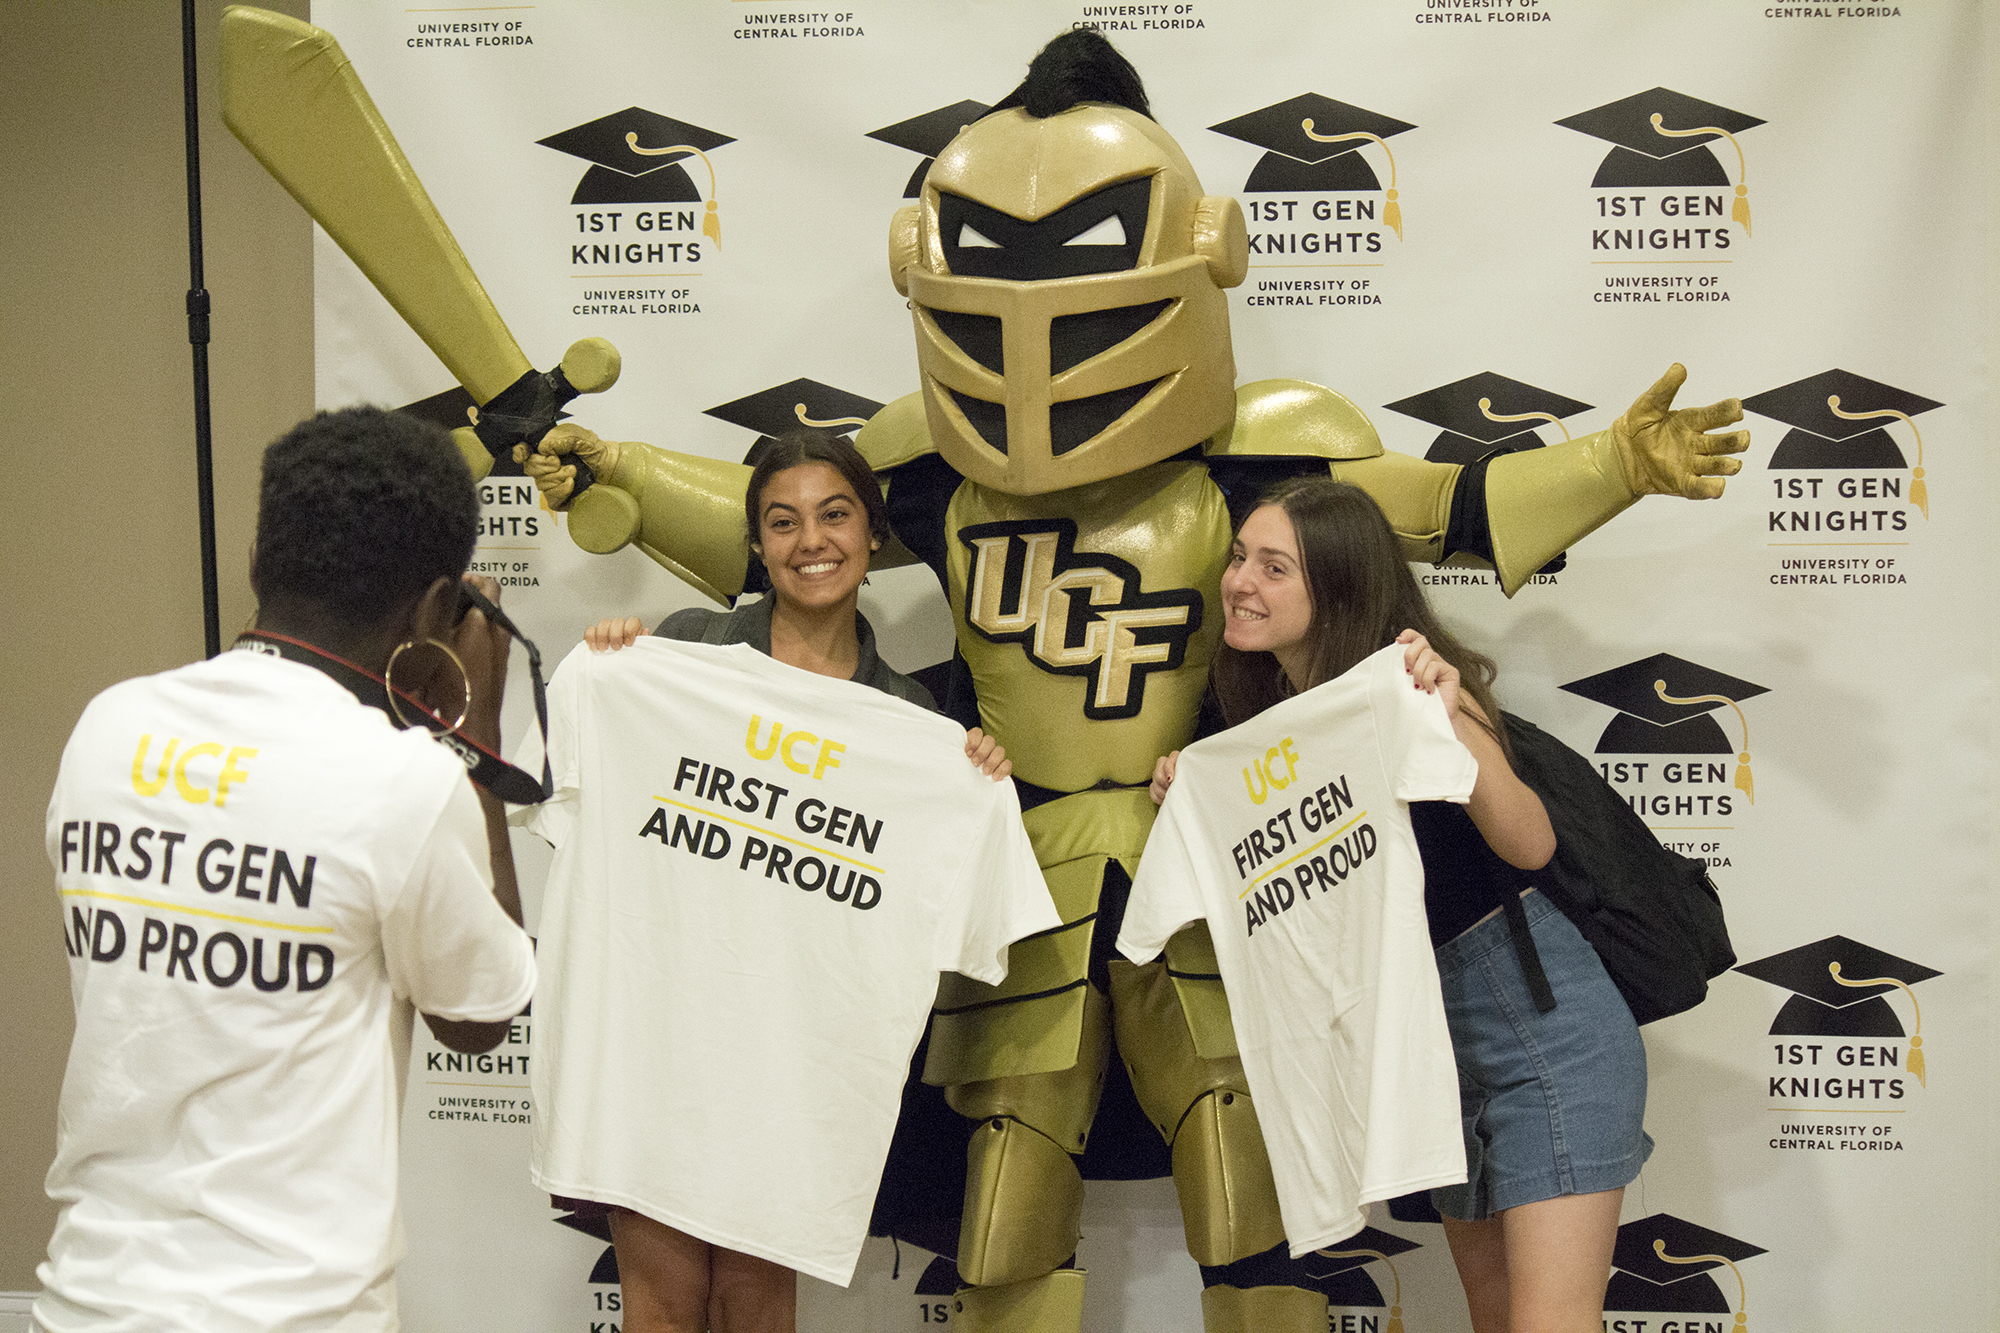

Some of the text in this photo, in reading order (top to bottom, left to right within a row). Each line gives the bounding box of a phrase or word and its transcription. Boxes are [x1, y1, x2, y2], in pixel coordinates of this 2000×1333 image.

[1083, 5, 1193, 16] UNIVERSITY OF
[1427, 0, 1513, 8] UNIVERSITY
[1764, 7, 1901, 18] CENTRAL FLORIDA
[744, 13, 854, 24] UNIVERSITY OF
[1072, 19, 1205, 30] CENTRAL FLORIDA
[1415, 12, 1552, 23] CENTRAL FLORIDA
[417, 22, 523, 33] UNIVERSITY OF
[733, 27, 865, 39] CENTRAL FLORIDA
[406, 36, 534, 48] CENTRAL FLORIDA
[1249, 200, 1375, 221] 1ST GEN
[1596, 196, 1723, 216] 1ST GEN
[576, 212, 695, 232] 1ST GEN
[1248, 232, 1381, 254] KNIGHTS
[1592, 229, 1731, 249] KNIGHTS
[572, 243, 701, 264] KNIGHTS
[1258, 280, 1370, 291] UNIVERSITY OF
[1605, 277, 1719, 287] UNIVERSITY OF
[583, 289, 690, 300] UNIVERSITY OF
[1246, 295, 1382, 306] CENTRAL FLORIDA
[1593, 292, 1731, 302] CENTRAL FLORIDA
[572, 304, 701, 315] CENTRAL FLORIDA
[479, 485, 532, 505] GEN
[1773, 478, 1901, 498] 1ST GEN
[477, 517, 539, 536] GHTS
[1769, 511, 1907, 531] KNIGHTS
[468, 562, 529, 572] RSITY OF
[1781, 559, 1895, 569] UNIVERSITY OF
[499, 577, 540, 587] ORIDA
[1421, 575, 1489, 585] CENTRAL
[1769, 574, 1907, 584] CENTRAL FLORIDA
[970, 531, 1190, 708] UCF
[745, 714, 847, 780] UCF
[131, 733, 259, 808] UCF
[1242, 736, 1299, 805] UCF
[1600, 762, 1726, 783] 1ST GEN
[672, 756, 884, 855] FIRST GEN
[1630, 795, 1733, 816] IGHTS
[1231, 773, 1354, 880] FIRST GEN
[1700, 843, 1720, 852] OF
[60, 821, 317, 908] FIRST GEN
[638, 806, 882, 911] AND PROUD
[1245, 822, 1378, 938] AND PROUD
[138, 918, 336, 992] PROUD
[427, 1052, 530, 1075] KNIGHT
[1774, 1045, 1898, 1066] 1ST GEN
[1769, 1077, 1905, 1099] KNIGHTS
[438, 1097, 531, 1110] UNIVERSITY O
[428, 1110, 531, 1123] CENTRAL FLORI
[1780, 1125, 1892, 1136] UNIVERSITY OF
[1768, 1139, 1904, 1150] CENTRAL FLORIDA
[593, 1291, 622, 1312] 1S
[920, 1303, 949, 1324] 1S
[1660, 1320, 1723, 1333] GEN
